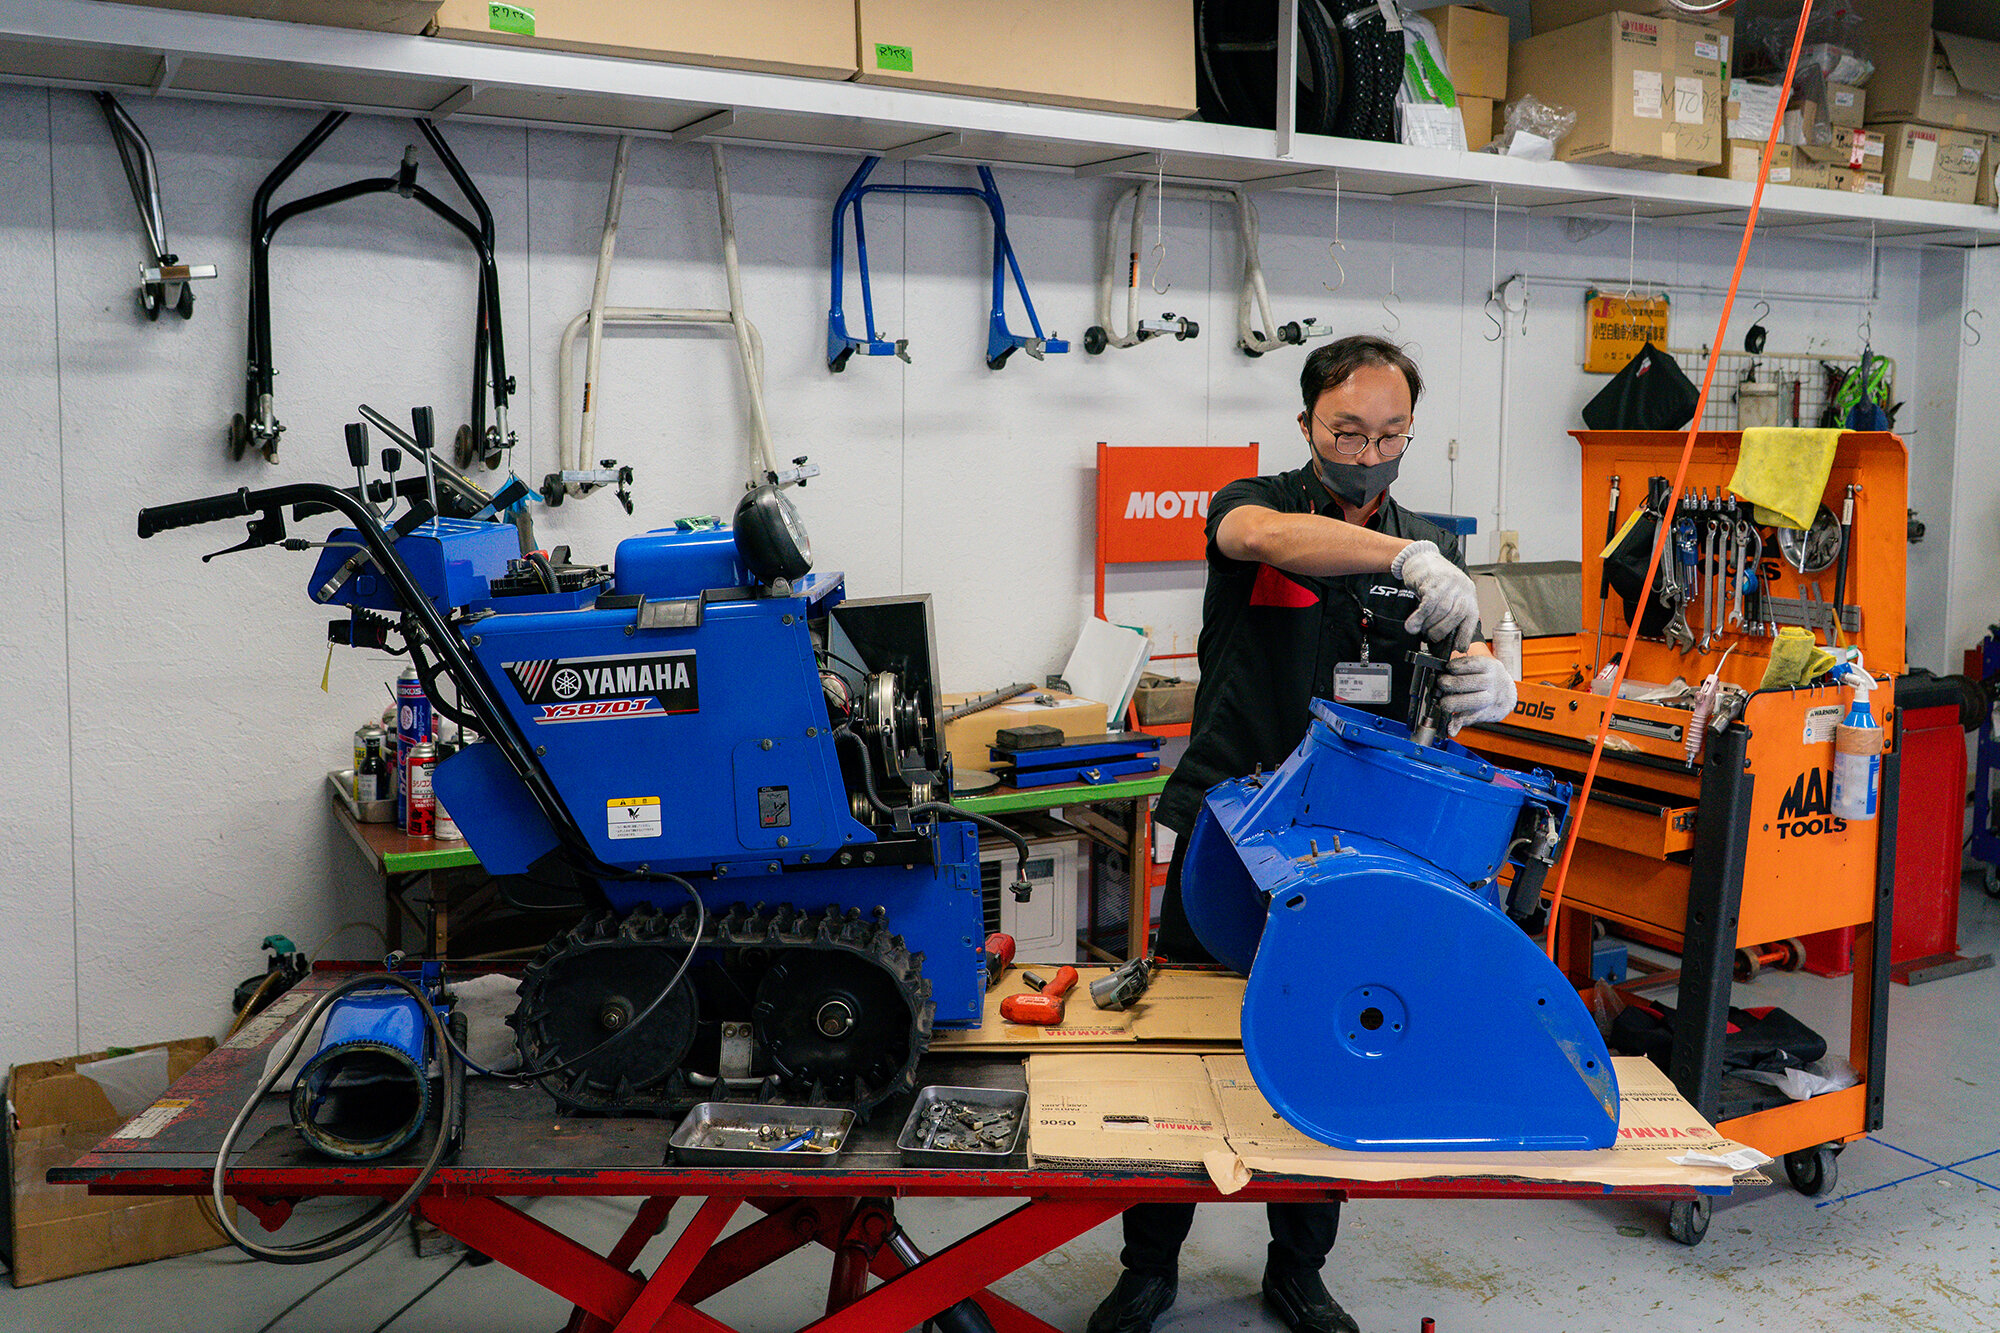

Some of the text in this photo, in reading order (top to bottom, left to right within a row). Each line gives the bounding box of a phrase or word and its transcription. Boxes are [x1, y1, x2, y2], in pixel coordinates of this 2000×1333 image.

[1631, 21, 1657, 34] YAMAHA
[1124, 491, 1218, 519] MOTU
[583, 662, 690, 695] YAMAHA
[1512, 701, 1556, 720] ools
[1814, 708, 1839, 717] WARNING
[1777, 767, 1834, 820] MA
[1776, 817, 1847, 840] TOOLS
[1039, 1119, 1077, 1127] 0506
[1154, 1123, 1200, 1131] YAMAHA
[1617, 1127, 1689, 1139] YAMA
